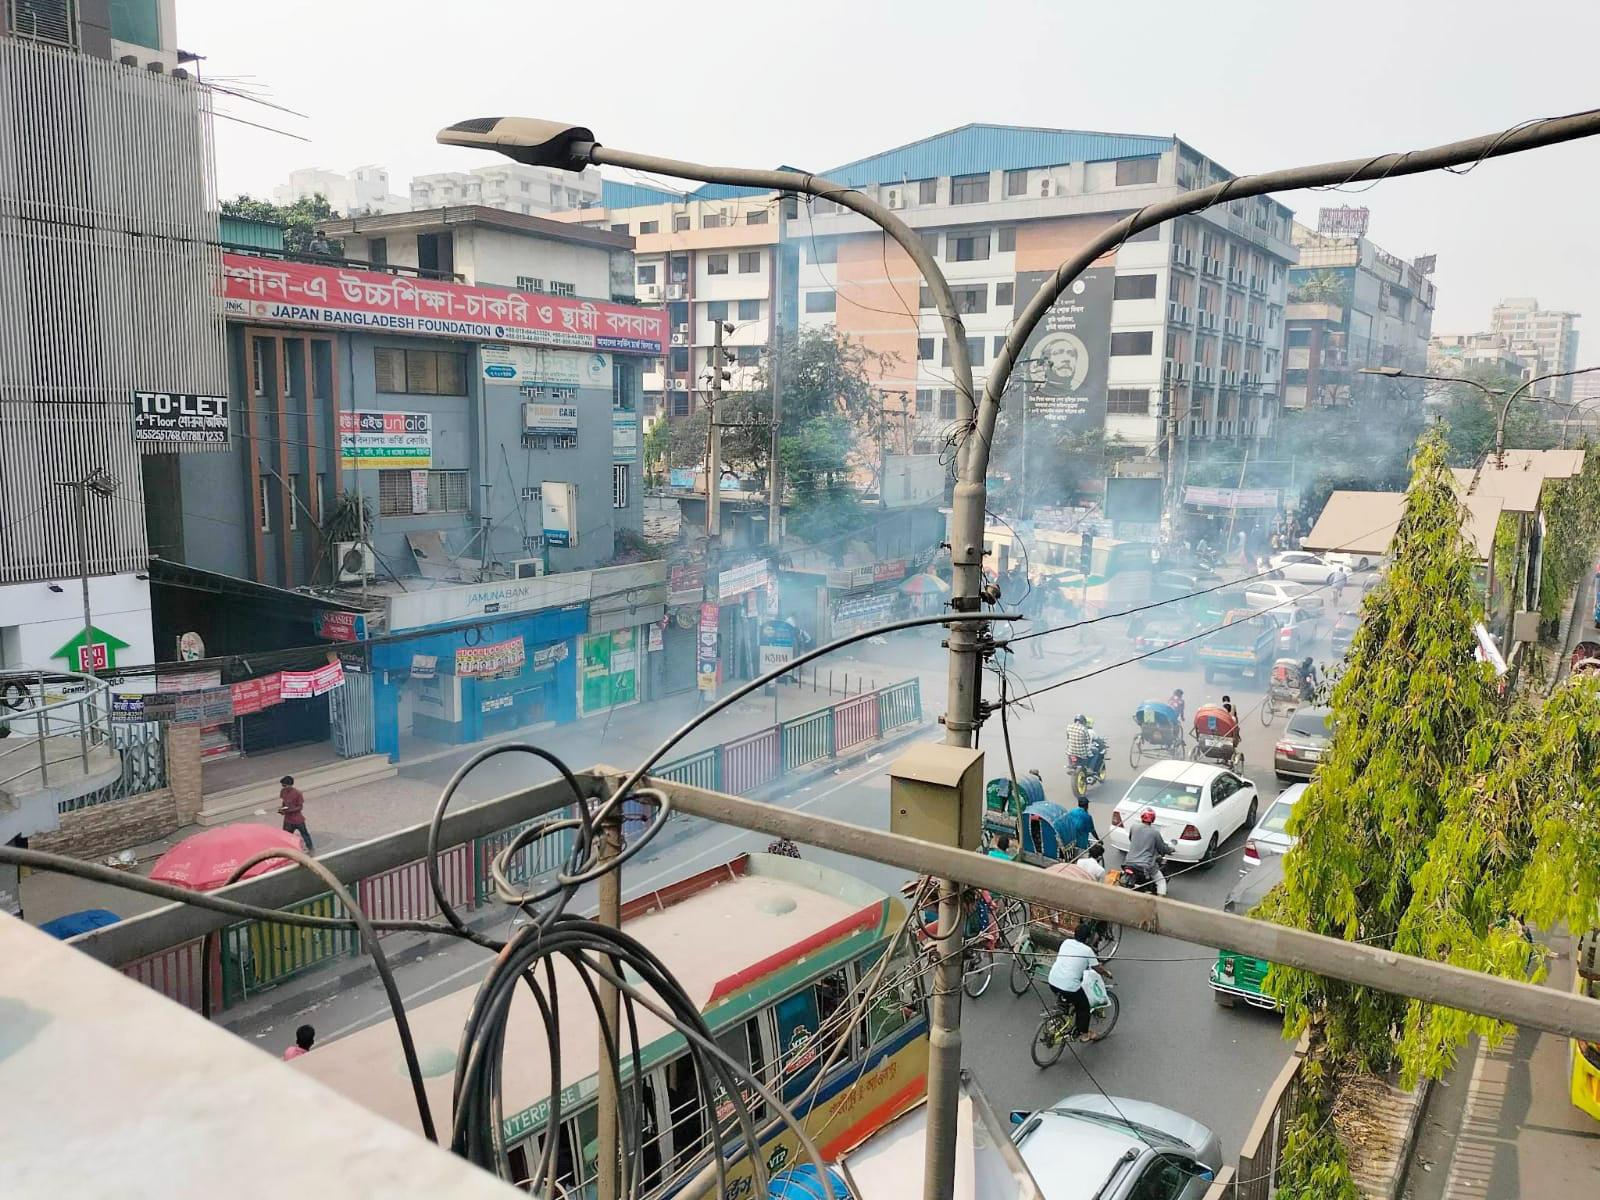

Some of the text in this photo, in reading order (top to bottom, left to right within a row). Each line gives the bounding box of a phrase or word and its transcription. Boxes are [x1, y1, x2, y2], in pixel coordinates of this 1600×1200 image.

[272, 305, 491, 336] JAPAN BANGLADESH FOUNDATION
[537, 304, 553, 325] ও
[605, 312, 662, 336] বসবাস
[136, 393, 227, 416] TO-LET
[149, 414, 176, 427] Floor
[384, 414, 427, 431] uniaid
[466, 586, 530, 606] JAMUNA BANK
[503, 1088, 576, 1139] NTERPSE
